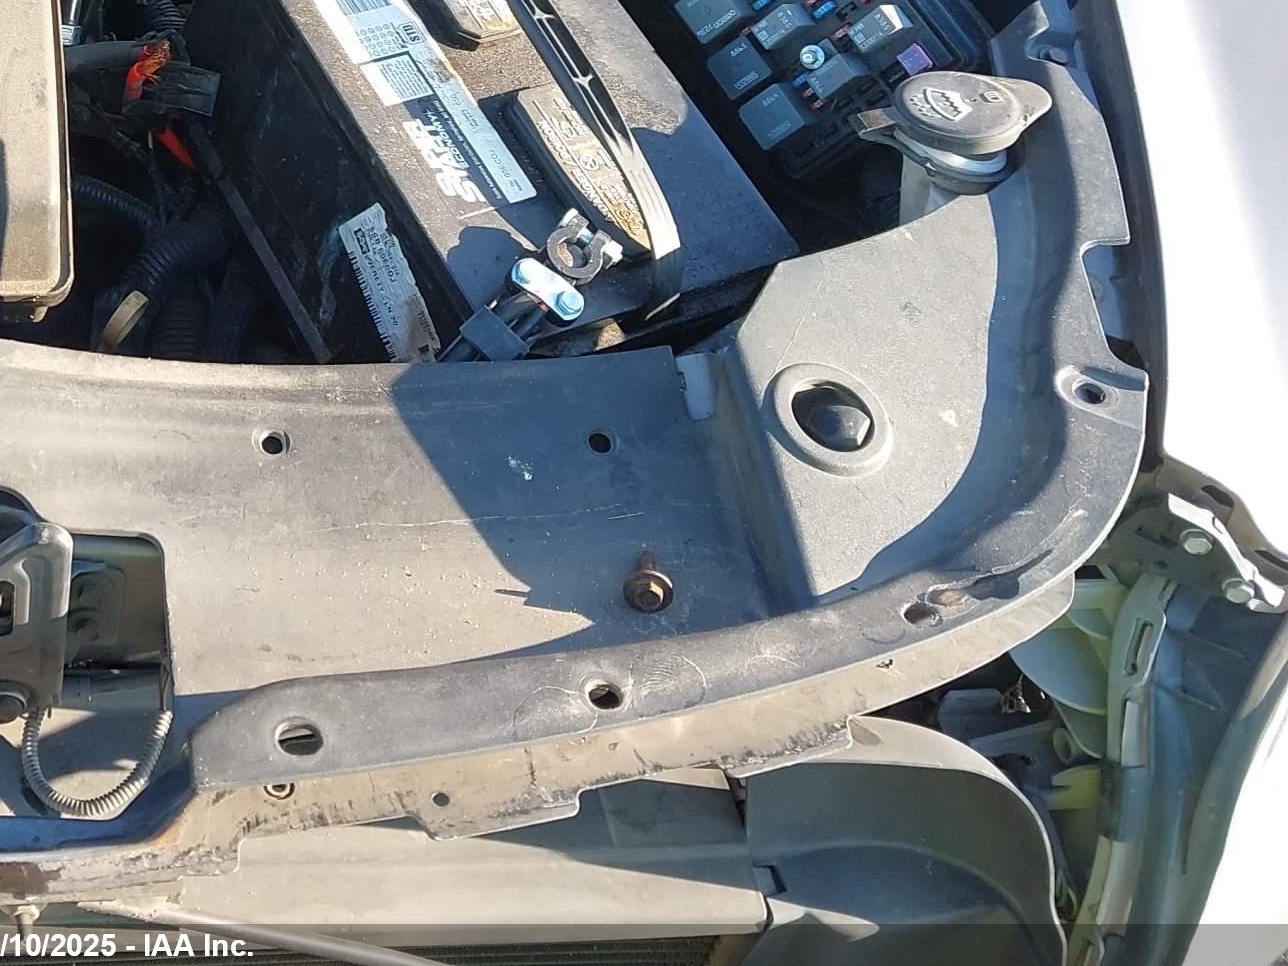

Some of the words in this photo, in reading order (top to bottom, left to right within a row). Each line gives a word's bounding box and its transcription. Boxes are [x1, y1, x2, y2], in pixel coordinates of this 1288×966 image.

[400, 23, 421, 42] STD
[412, 119, 485, 200] START
[536, 119, 571, 162] POISON
